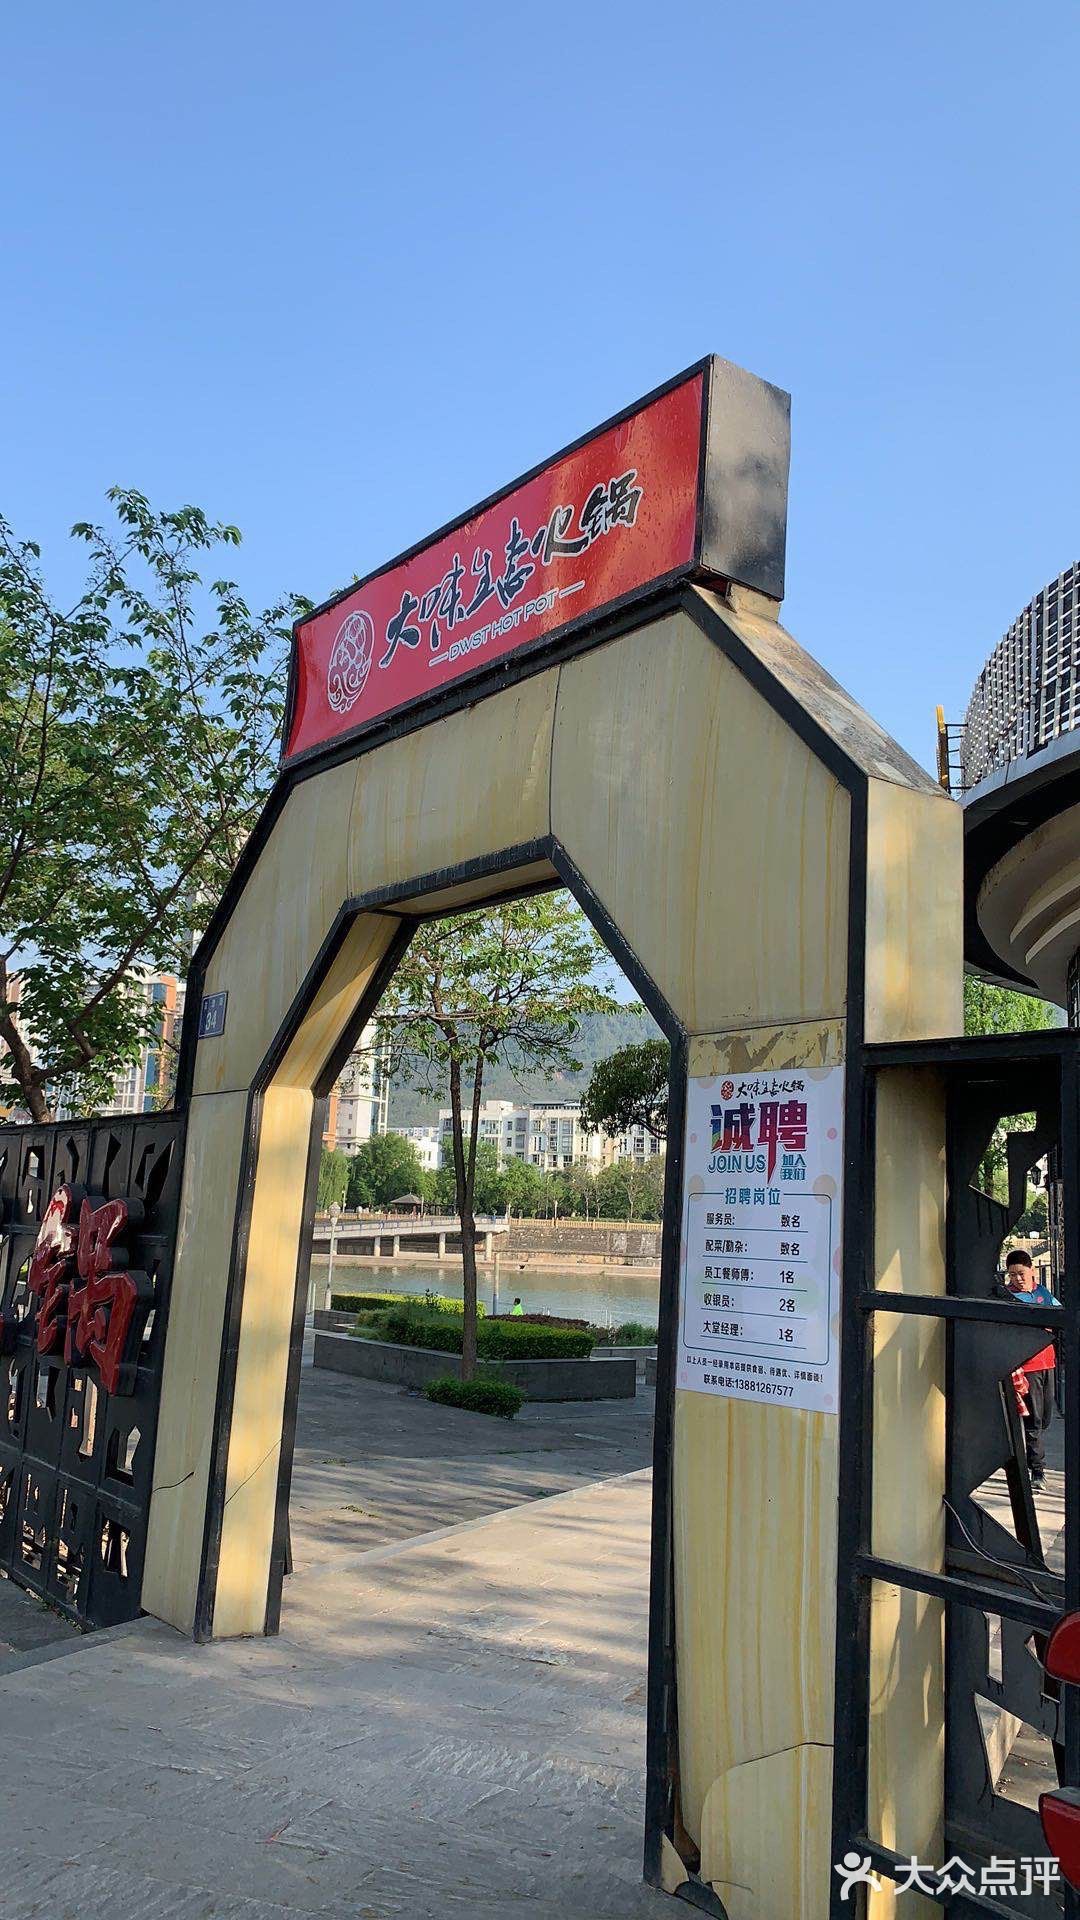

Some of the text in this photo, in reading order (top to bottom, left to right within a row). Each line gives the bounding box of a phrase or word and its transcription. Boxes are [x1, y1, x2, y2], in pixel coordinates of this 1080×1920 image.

[448, 588, 559, 661] DWST HOT POT
[710, 1100, 808, 1184] 诚聘
[708, 1154, 766, 1173] JOIN US
[782, 1153, 807, 1167] 加入
[781, 1168, 806, 1181] 我们
[725, 1187, 781, 1205] 招聘岗位
[780, 1214, 801, 1228] 数名
[780, 1242, 800, 1256] 数名
[779, 1271, 794, 1284] 1名
[779, 1299, 795, 1313] 2名
[778, 1329, 793, 1342] 1名
